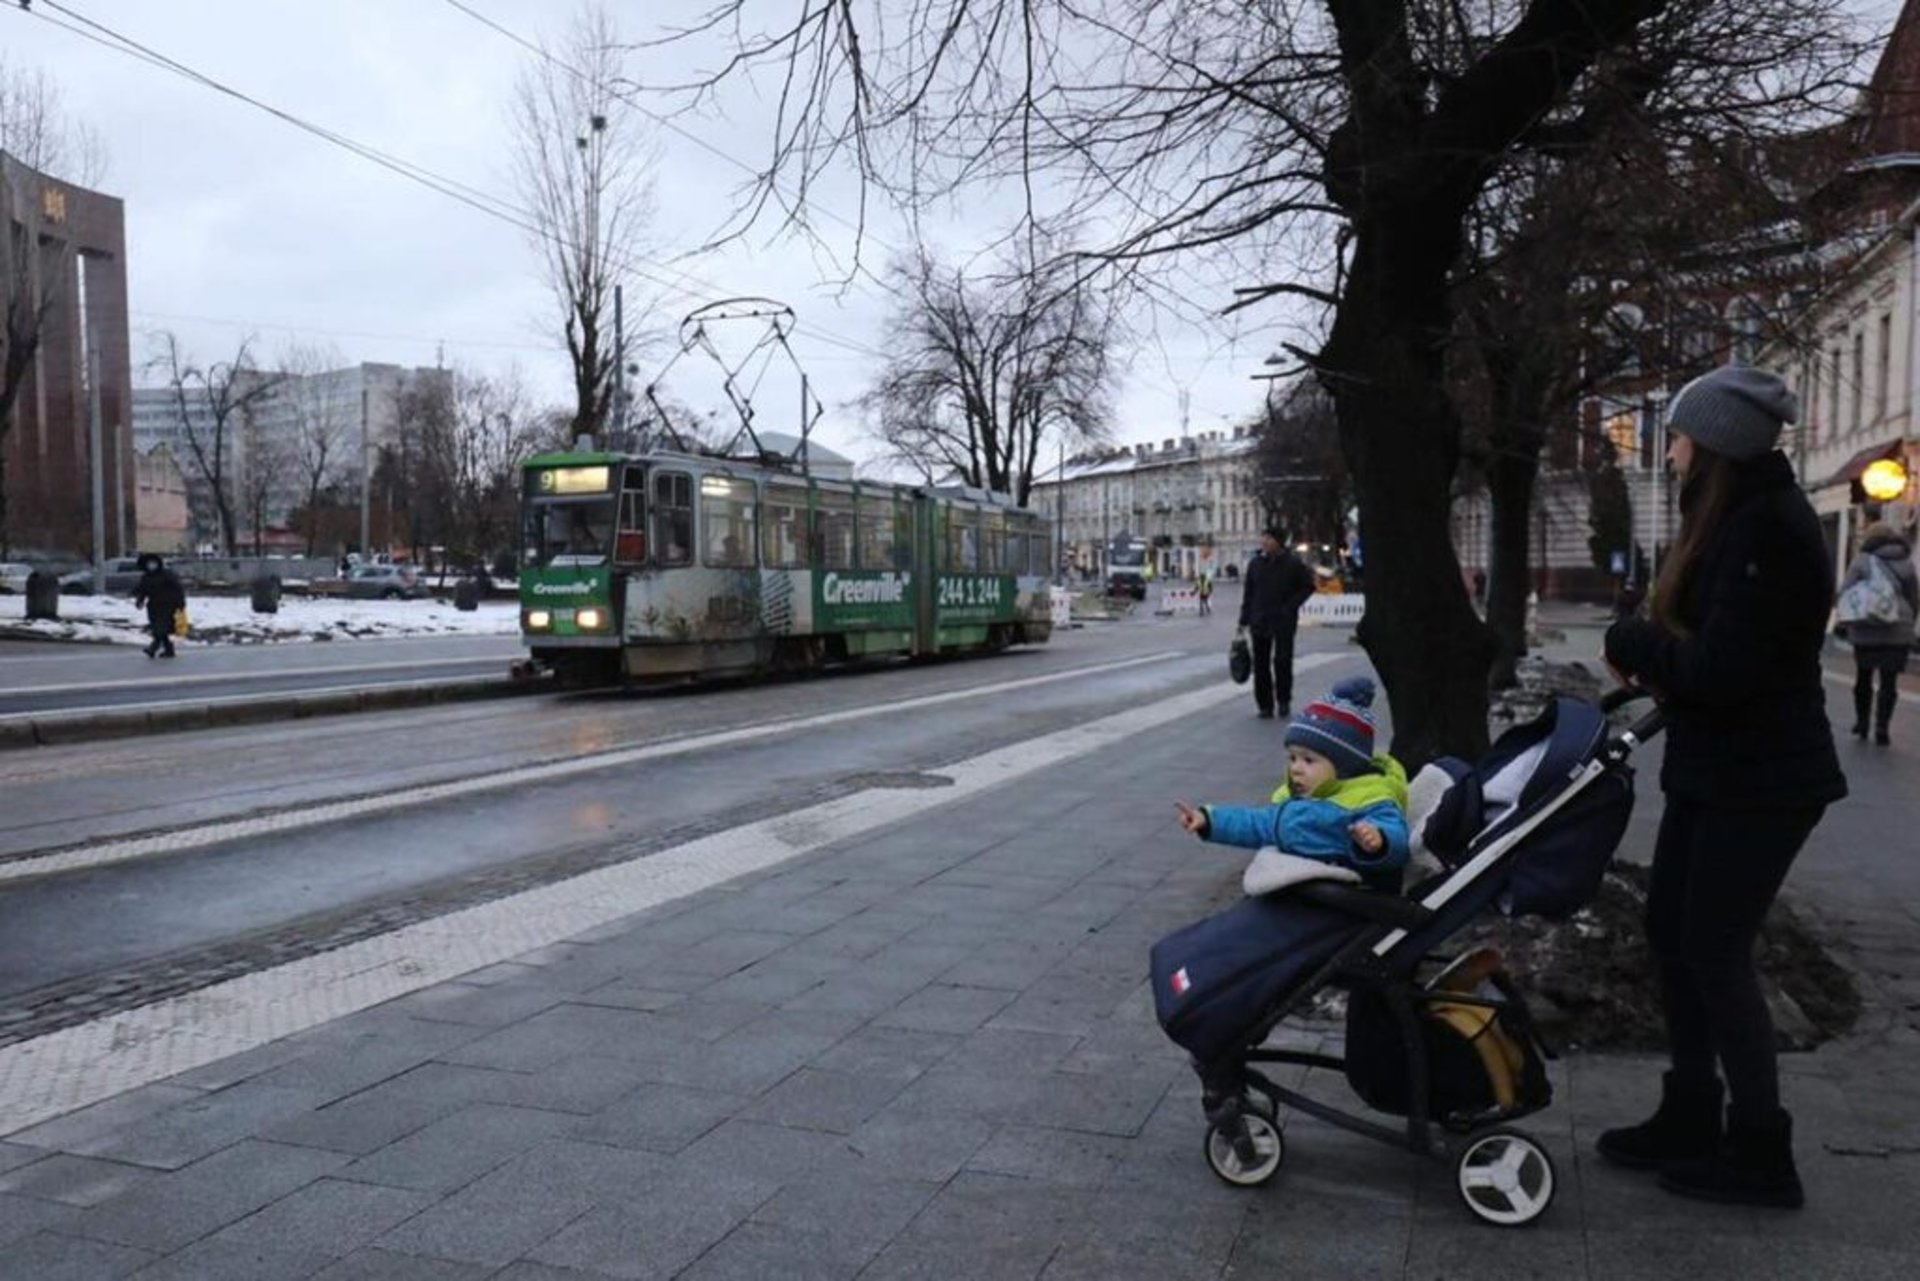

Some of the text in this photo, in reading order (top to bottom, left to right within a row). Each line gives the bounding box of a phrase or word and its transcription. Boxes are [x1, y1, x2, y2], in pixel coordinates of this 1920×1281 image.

[533, 582, 590, 595] Greenville
[823, 572, 903, 604] Greenville
[939, 578, 1000, 605] 244 1 244
